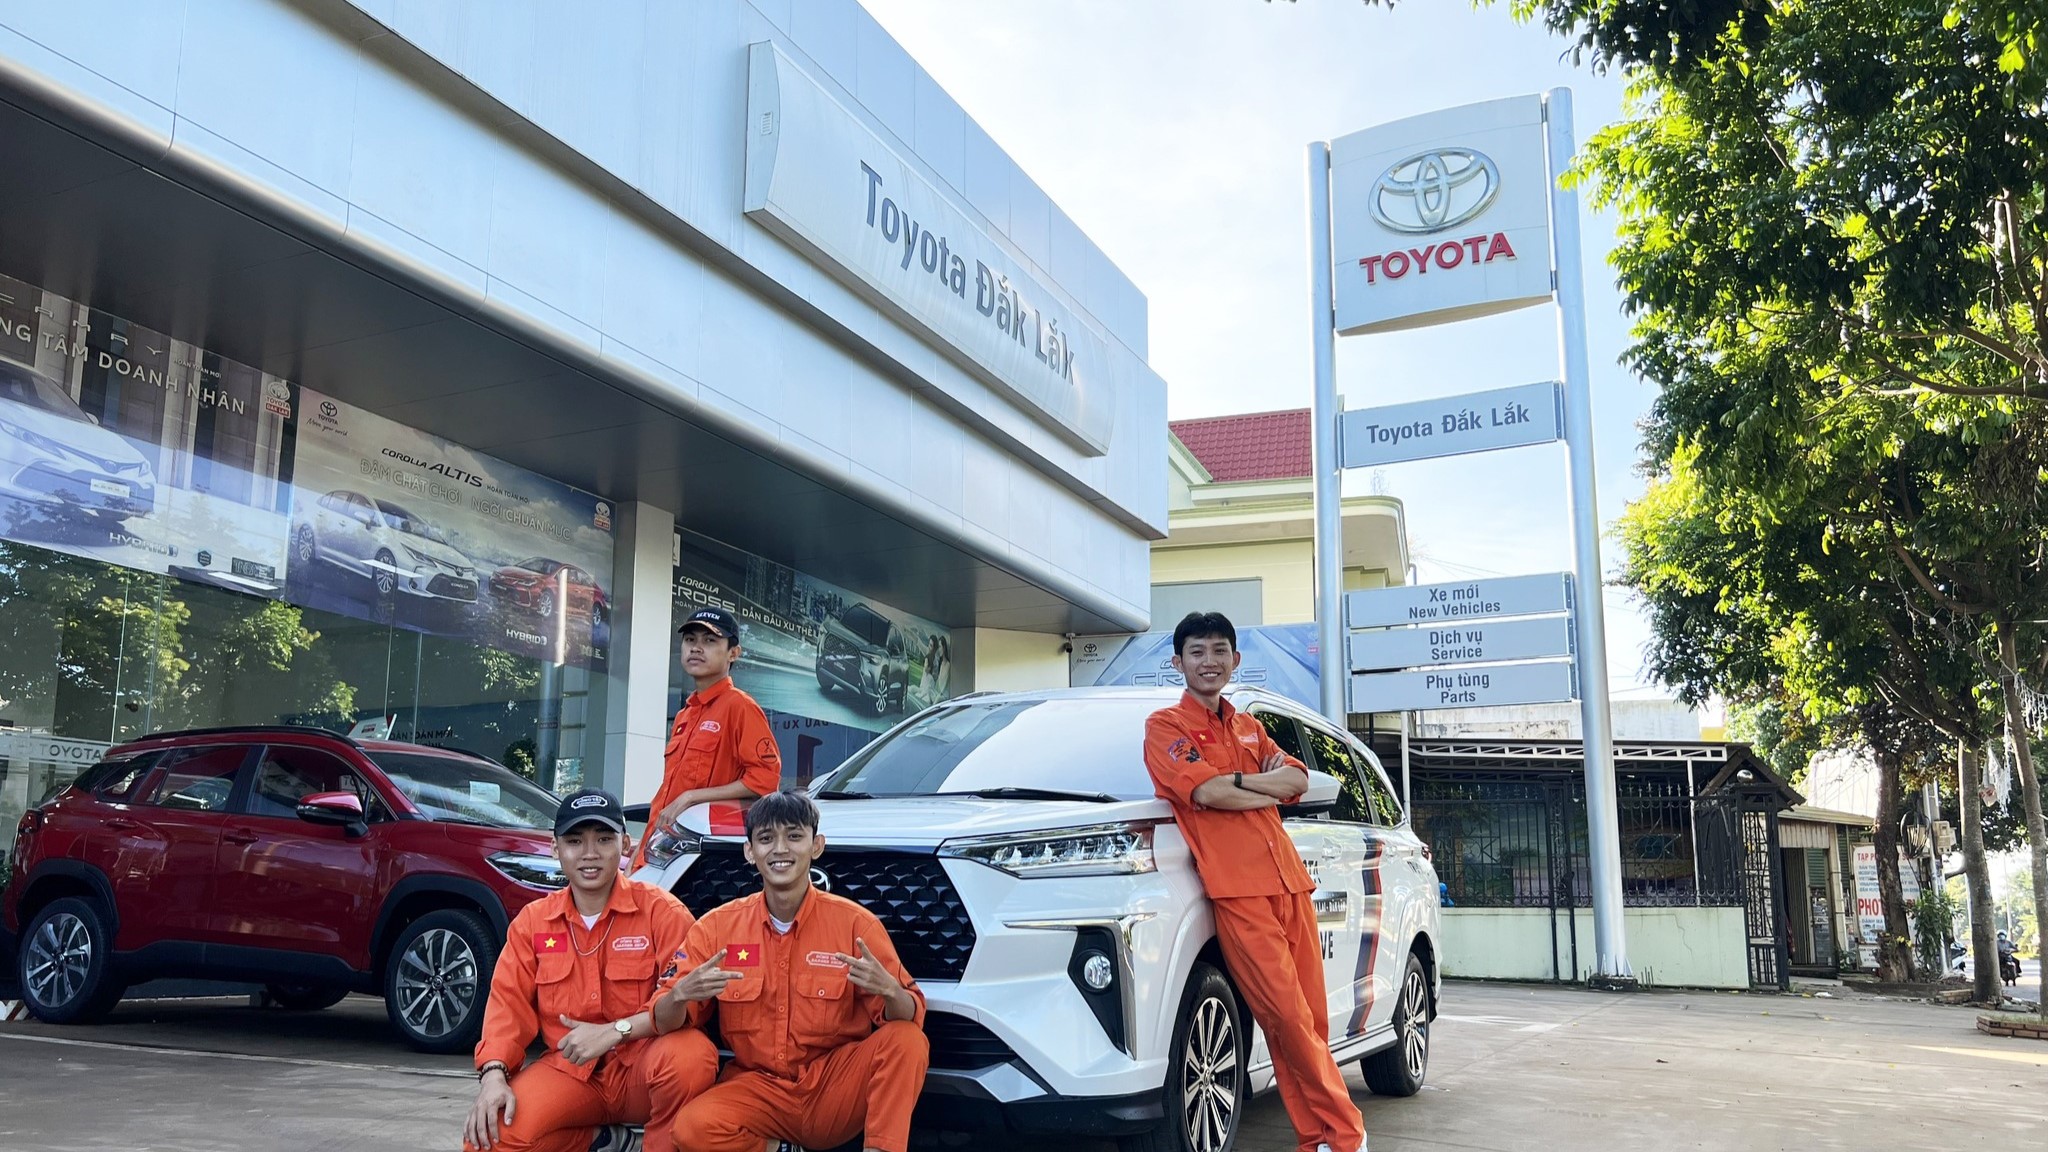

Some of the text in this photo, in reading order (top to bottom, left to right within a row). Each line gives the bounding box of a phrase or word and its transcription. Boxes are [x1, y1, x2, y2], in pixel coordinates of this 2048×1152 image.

[1358, 232, 1517, 285] TOYOTA
[860, 159, 1075, 386] Toyota Đắk Lắk
[42, 331, 89, 362] TÂM
[98, 351, 179, 393] DOANH
[187, 382, 246, 415] NHÂN
[318, 414, 339, 425] TOYOTA
[1366, 402, 1530, 445] Toyota Đắk Lắk
[381, 447, 427, 469] COROLLA
[428, 463, 483, 488] ALTIS
[679, 575, 720, 595] COROLLA
[1429, 585, 1480, 602] Xe mới
[1408, 599, 1501, 619] New Vehicles
[506, 629, 540, 644] HYBRID
[1430, 630, 1483, 647] Dịch vụ
[1431, 647, 1483, 660] Service
[1426, 672, 1490, 692] Phụ tùng
[1440, 690, 1476, 704] Parts
[40, 743, 102, 760] TOYOTA
